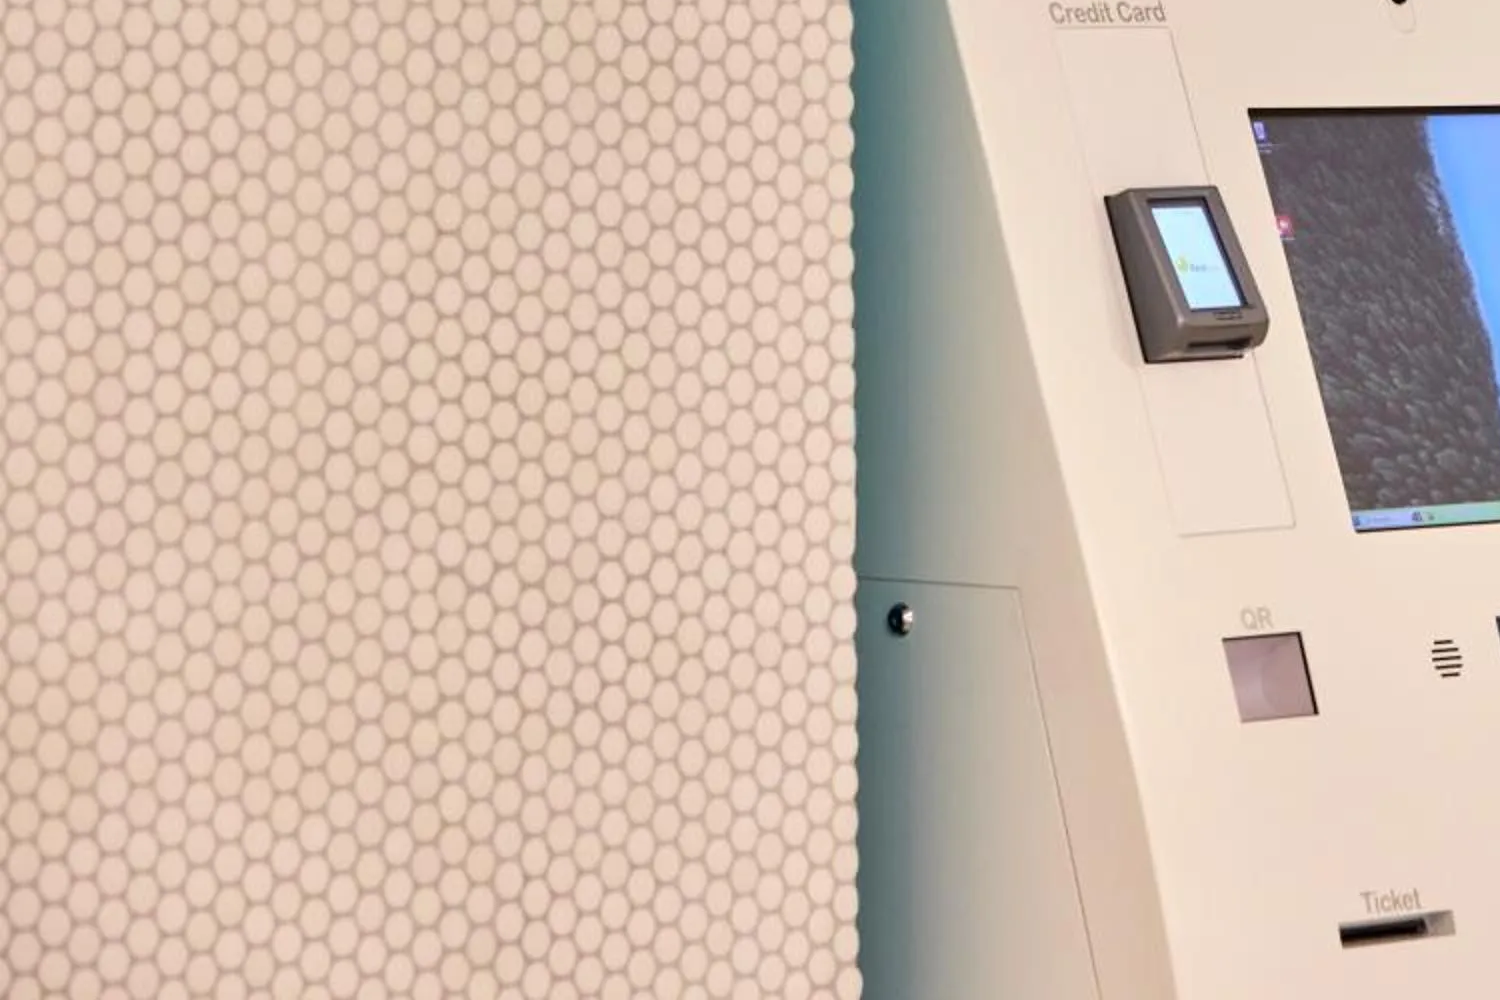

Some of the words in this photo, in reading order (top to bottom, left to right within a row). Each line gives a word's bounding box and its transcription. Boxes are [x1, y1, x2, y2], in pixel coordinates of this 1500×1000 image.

[1048, 0, 1114, 24] Credit
[1116, 0, 1167, 24] Card
[1240, 606, 1275, 631] QR
[1358, 887, 1423, 916] Ticket
